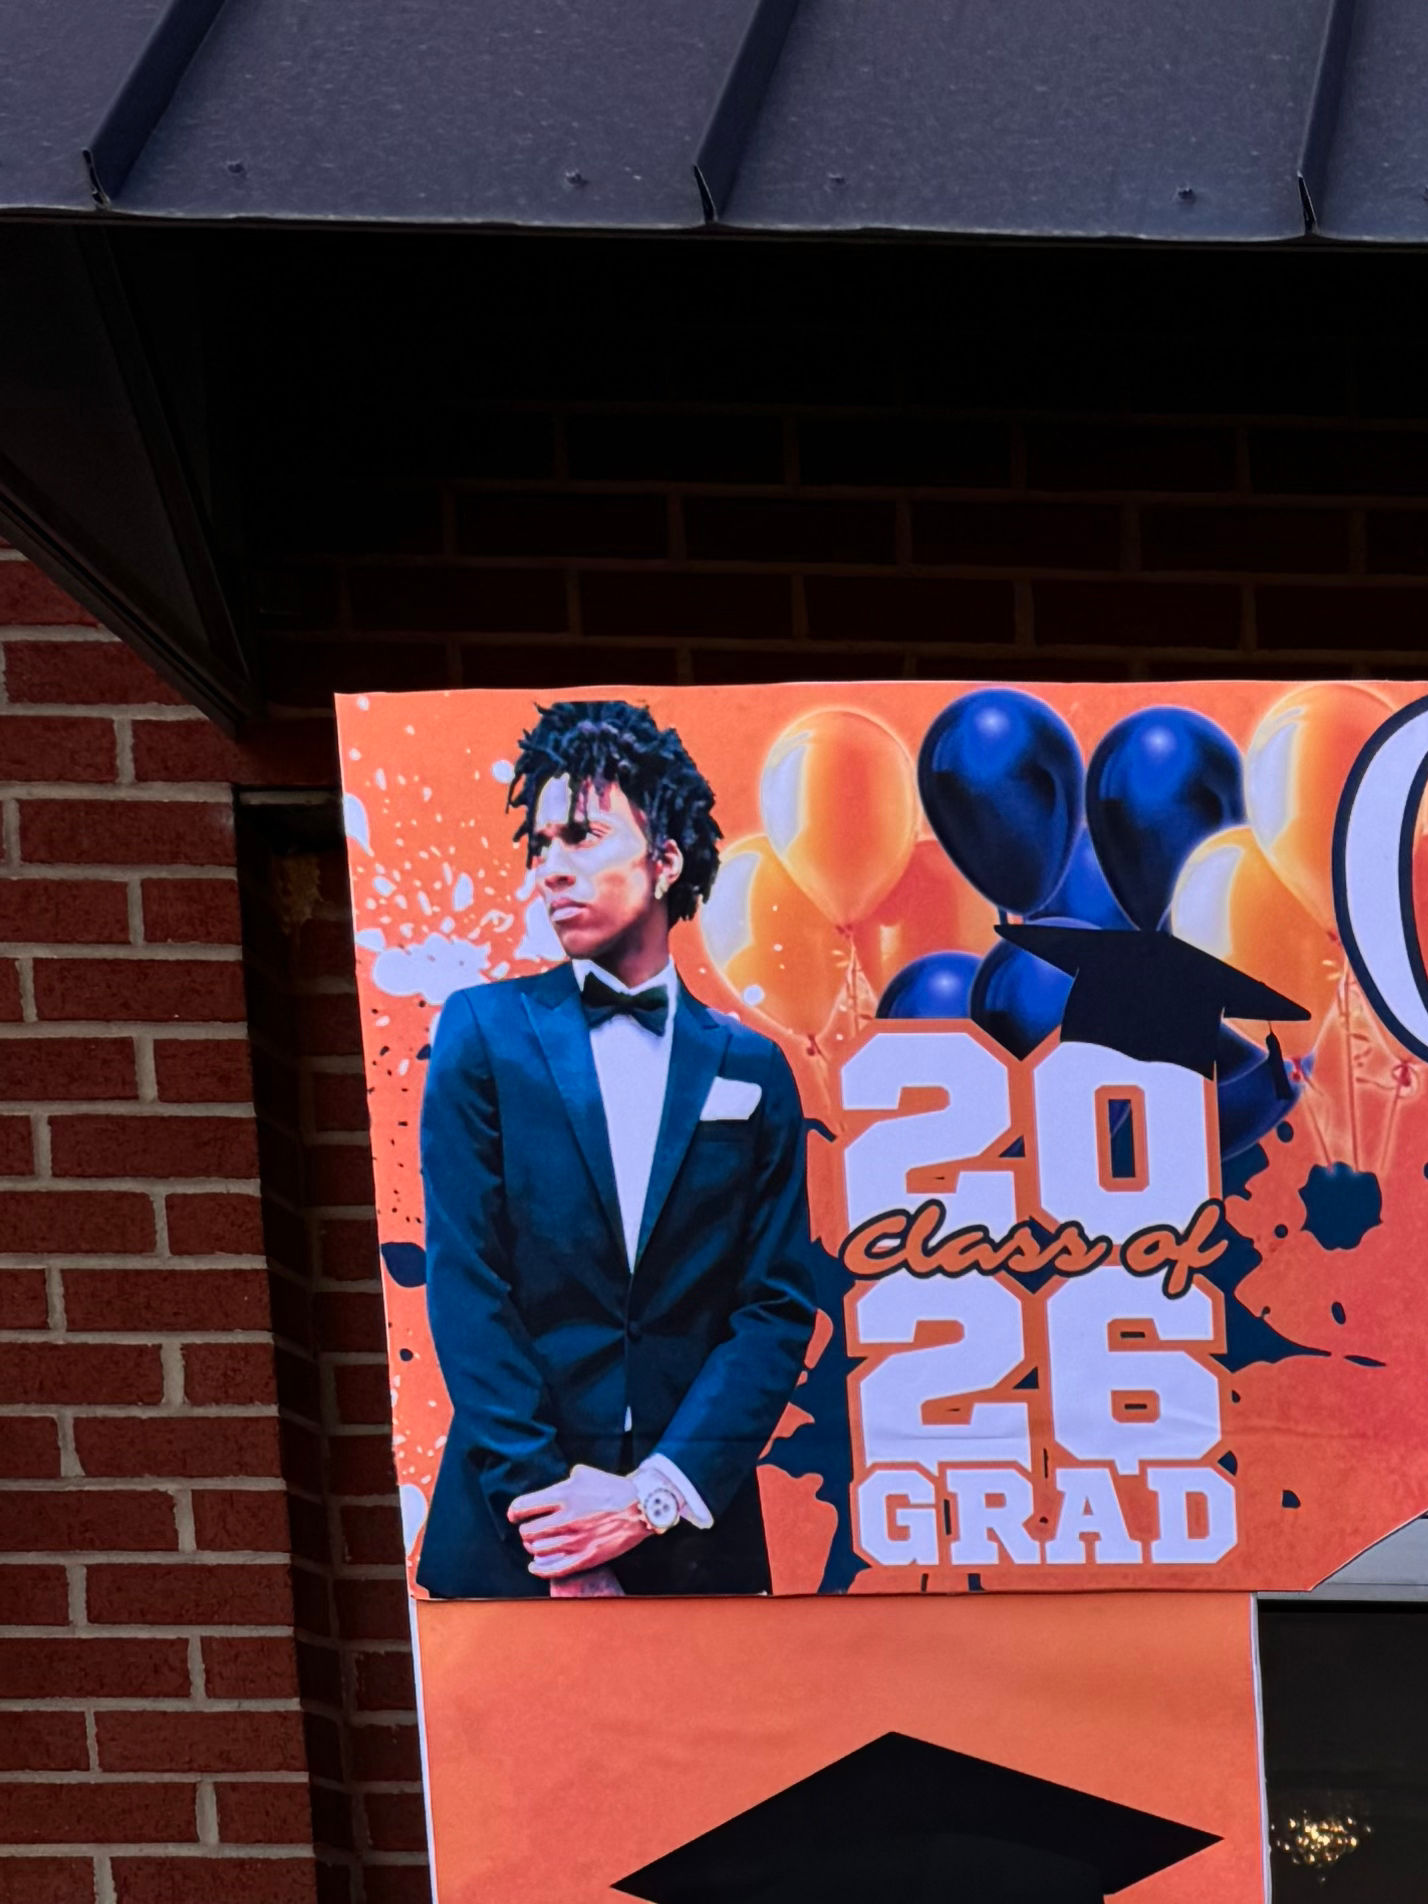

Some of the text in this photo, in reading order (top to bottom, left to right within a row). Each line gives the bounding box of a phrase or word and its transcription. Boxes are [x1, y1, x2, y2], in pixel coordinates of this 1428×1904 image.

[838, 1024, 1216, 1256] 20
[1119, 1198, 1230, 1300] of
[845, 1274, 1228, 1468] 26
[854, 1462, 1240, 1568] GRAD
